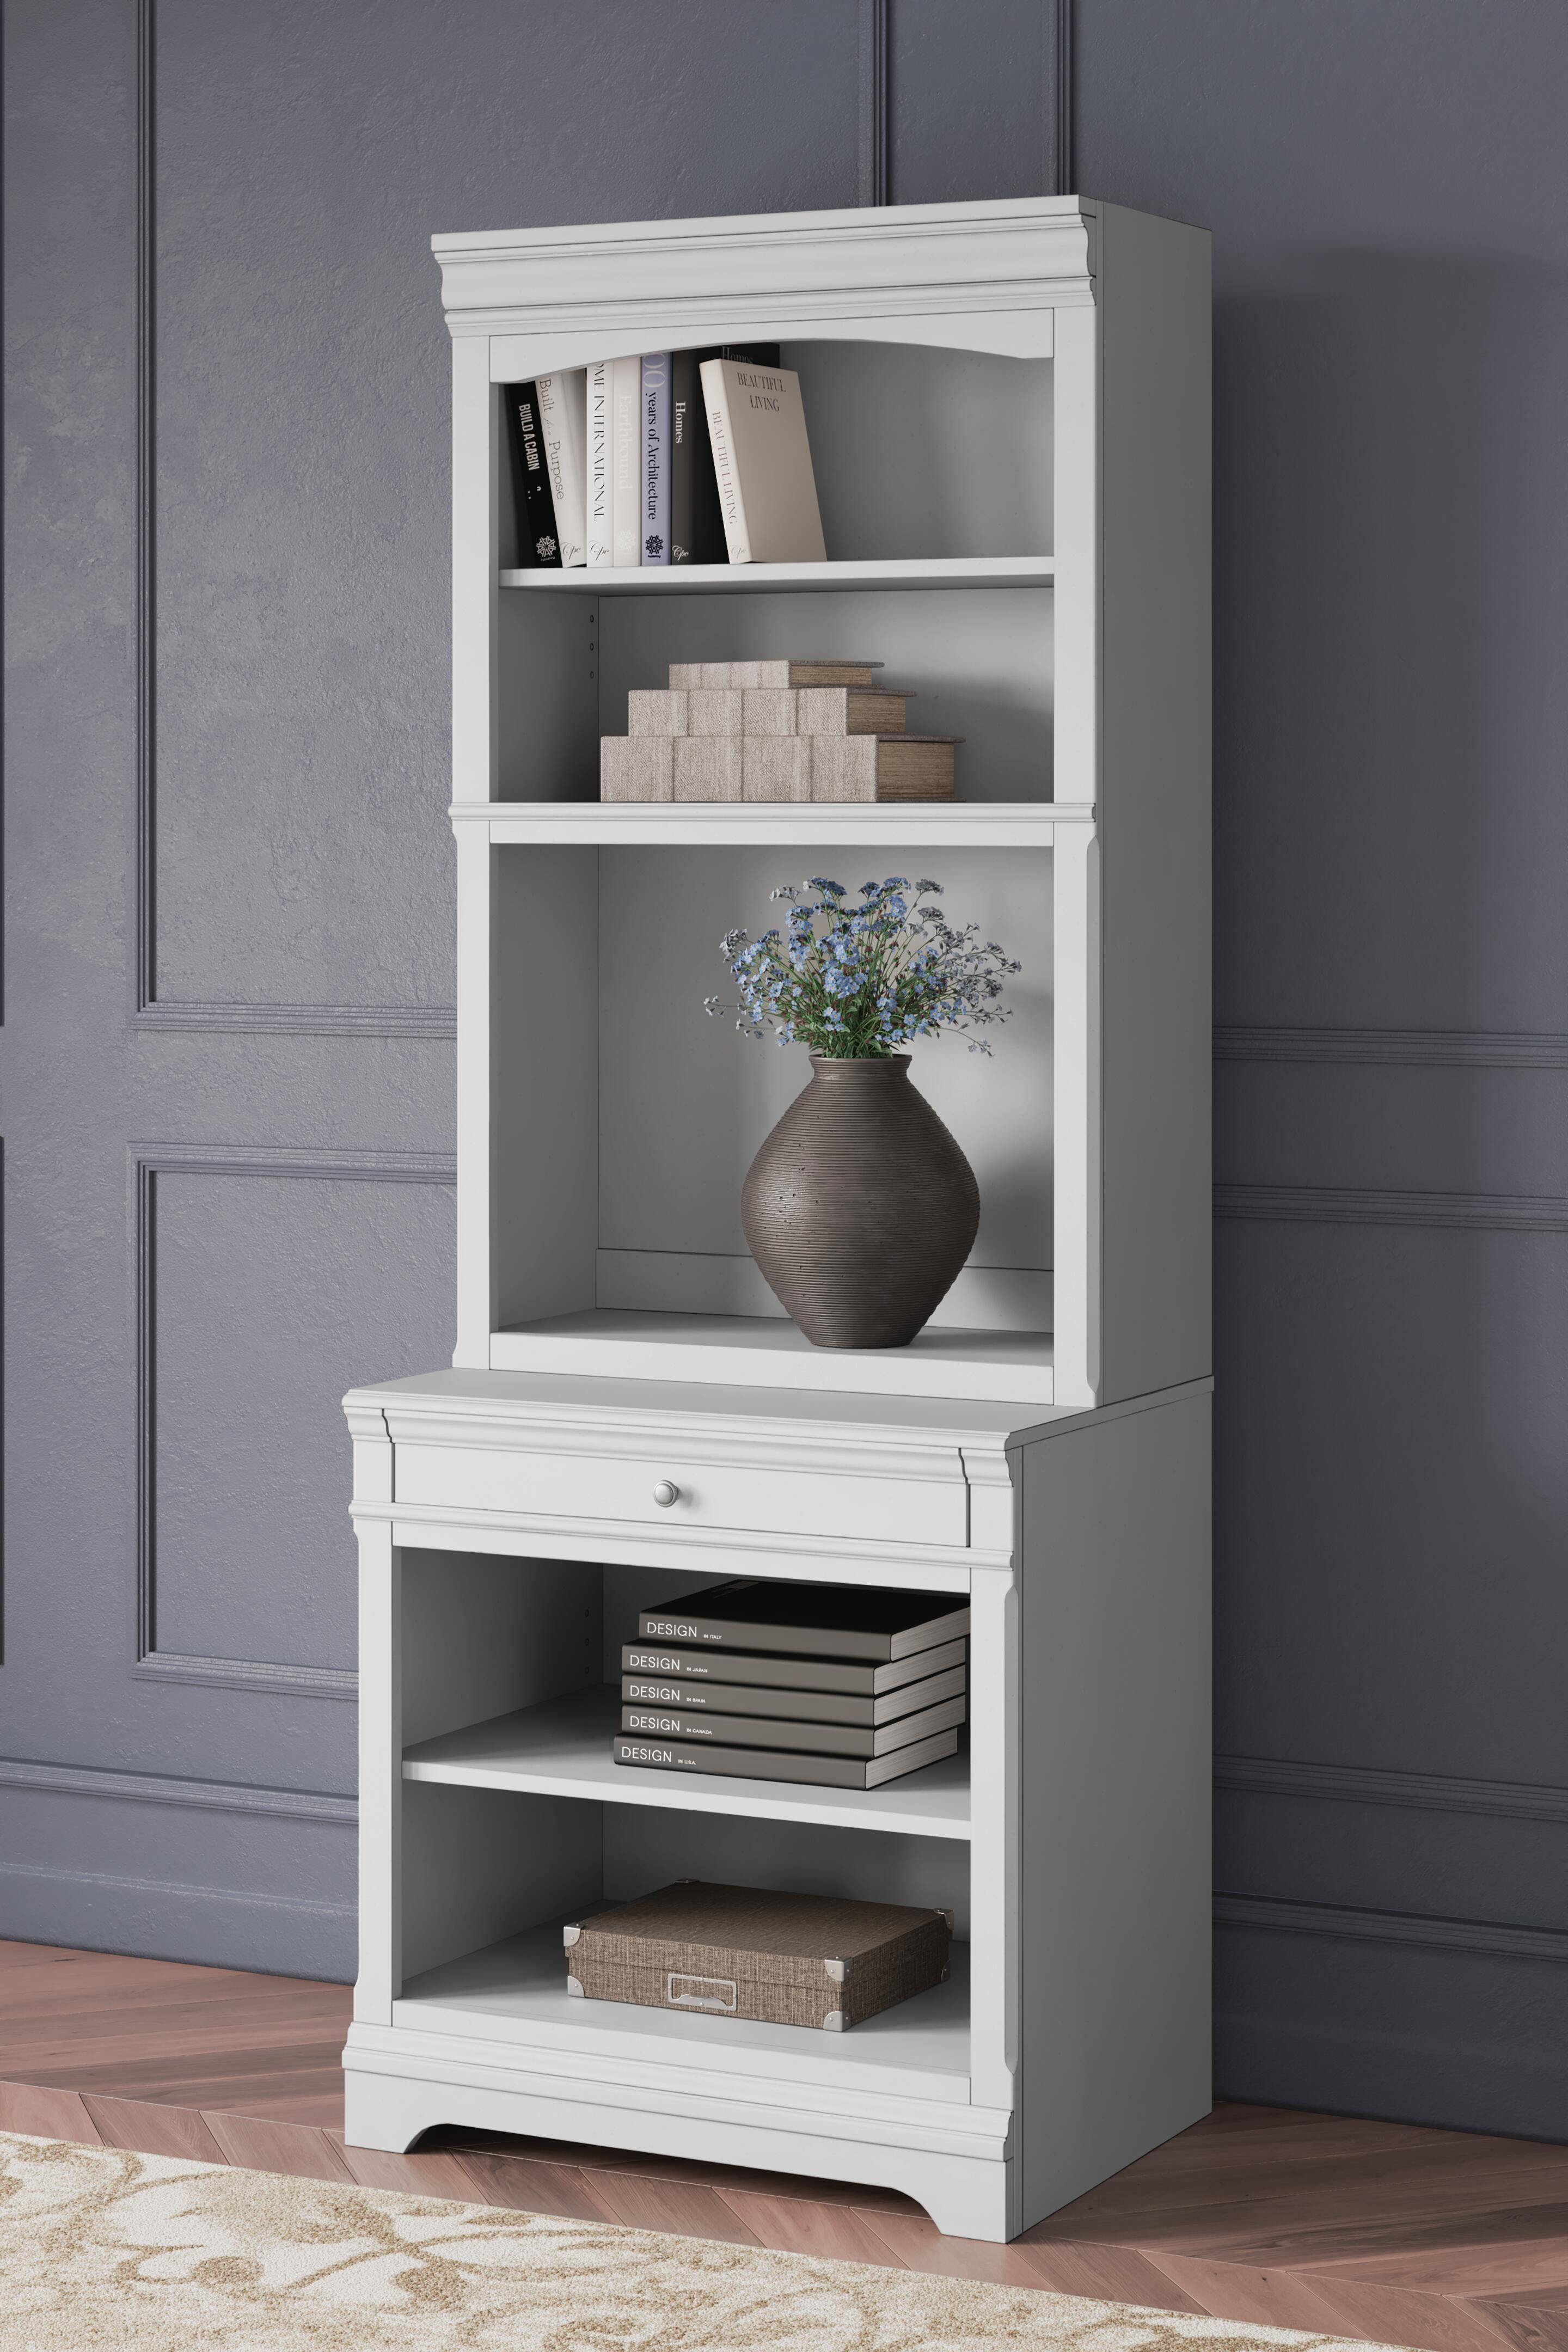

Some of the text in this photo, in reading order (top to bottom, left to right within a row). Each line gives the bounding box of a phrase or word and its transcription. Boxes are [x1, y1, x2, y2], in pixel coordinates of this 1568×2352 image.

[737, 372, 786, 392] BEAUTIFUL
[519, 403, 534, 432] BUILD
[646, 391, 656, 425] years
[750, 395, 780, 412] LIVING
[648, 428, 659, 442] of
[676, 401, 686, 444] Homes
[540, 378, 554, 412] Built
[549, 440, 564, 500] Purpose
[618, 395, 632, 490] Earthbound
[525, 441, 540, 470] CABIN
[593, 396, 604, 521] INTERNATIONAL
[712, 412, 737, 524] BEAUTIFUL LIVING
[648, 444, 659, 520] Architecture
[647, 1622, 697, 1638] DESIGN
[630, 1655, 680, 1670] DESIGN
[630, 1685, 680, 1701] DESIGN
[630, 1716, 680, 1731] DESIGN
[622, 1746, 672, 1762] DESIGN
